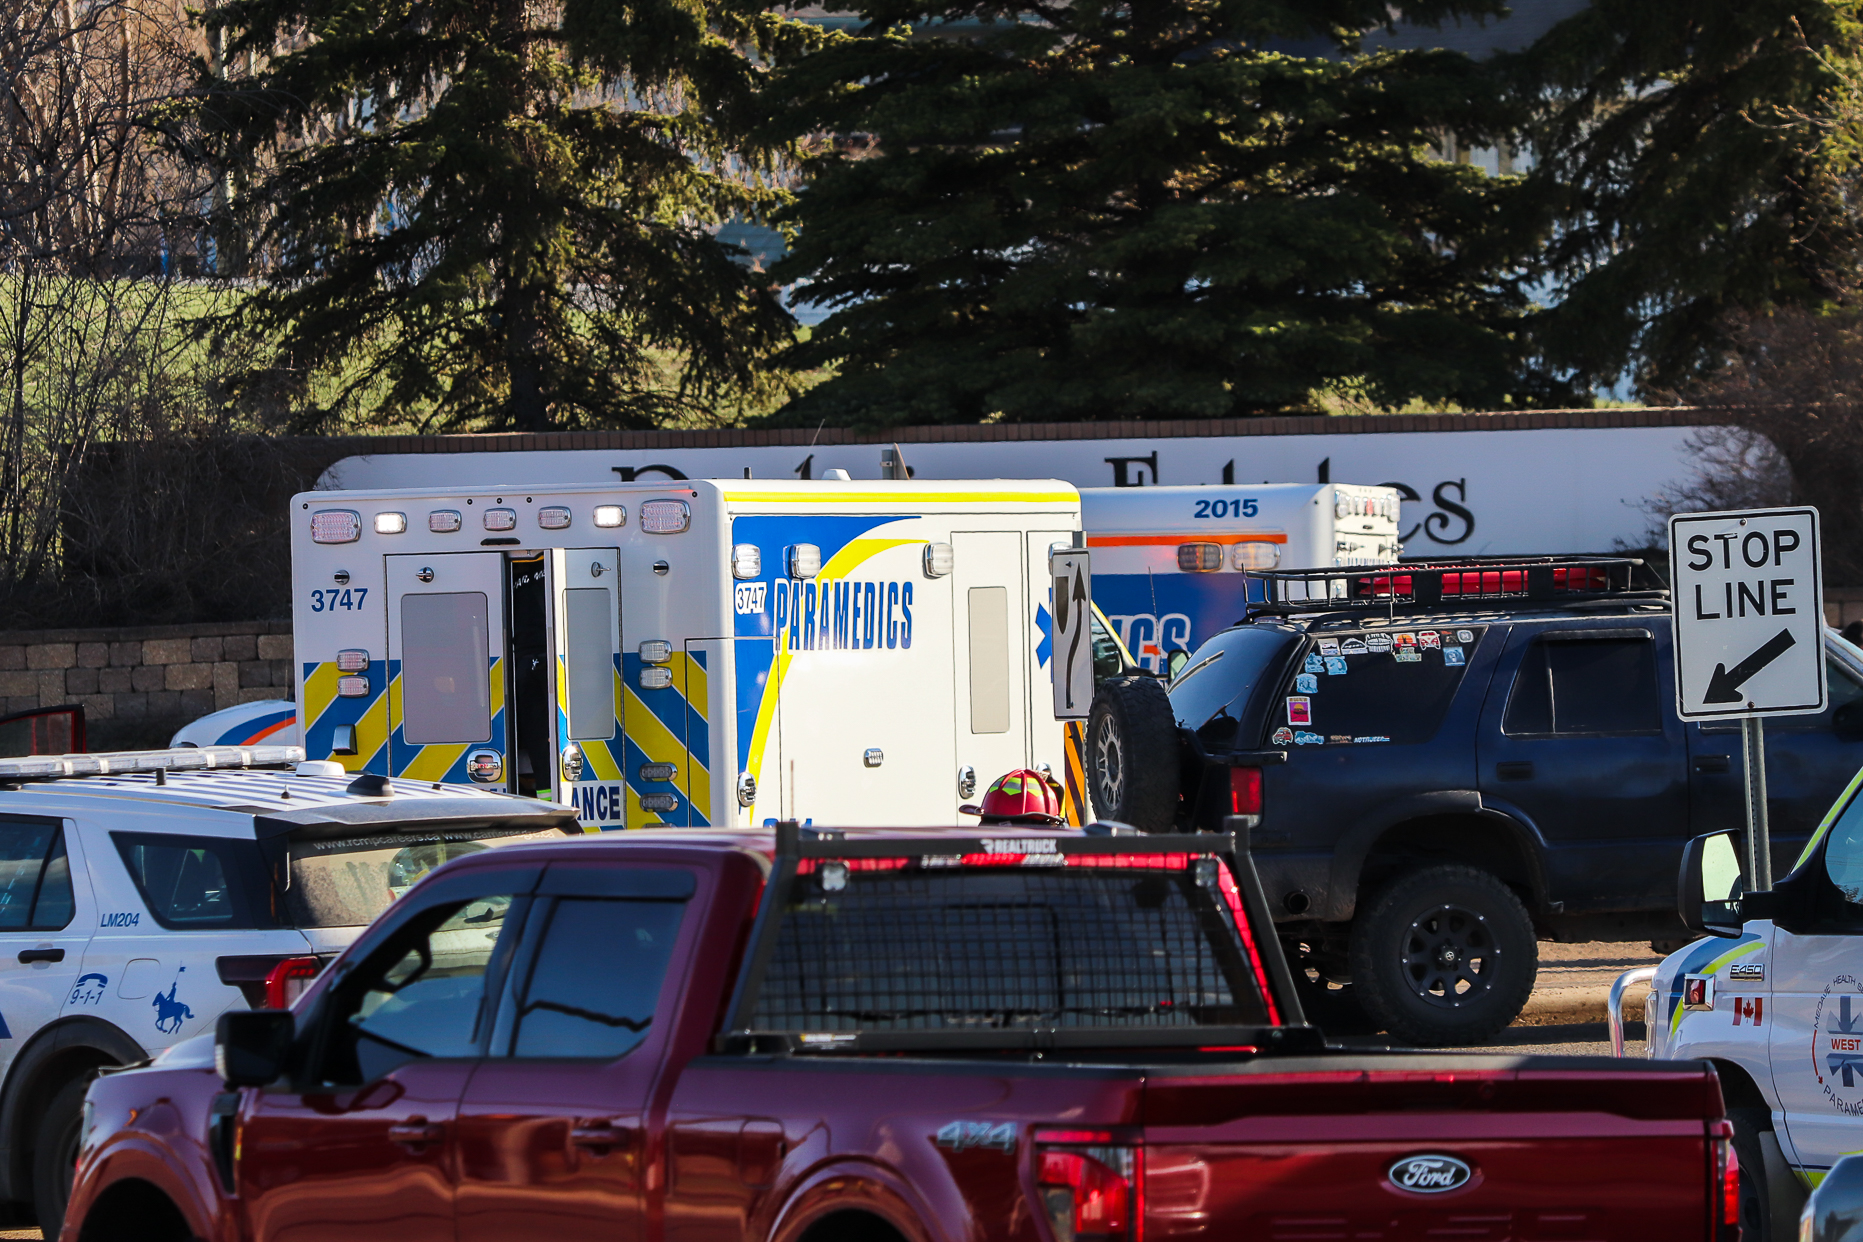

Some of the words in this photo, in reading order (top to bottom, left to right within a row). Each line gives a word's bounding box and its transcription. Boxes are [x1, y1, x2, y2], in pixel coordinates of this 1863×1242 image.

[1194, 498, 1259, 519] 2015
[1687, 529, 1800, 571] STOP
[310, 587, 368, 612] 3747
[736, 585, 766, 611] 3747
[1695, 578, 1796, 620] LINE
[775, 581, 914, 651] PARAMEDICS
[994, 838, 1057, 854] REALTRUCK
[100, 912, 140, 928] LM204
[1832, 974, 1857, 987] HEALTH
[70, 988, 104, 1005] 9-1-1
[1831, 1038, 1862, 1051] WEST
[1823, 1084, 1863, 1117] PARAME
[1403, 1160, 1456, 1187] Ford
